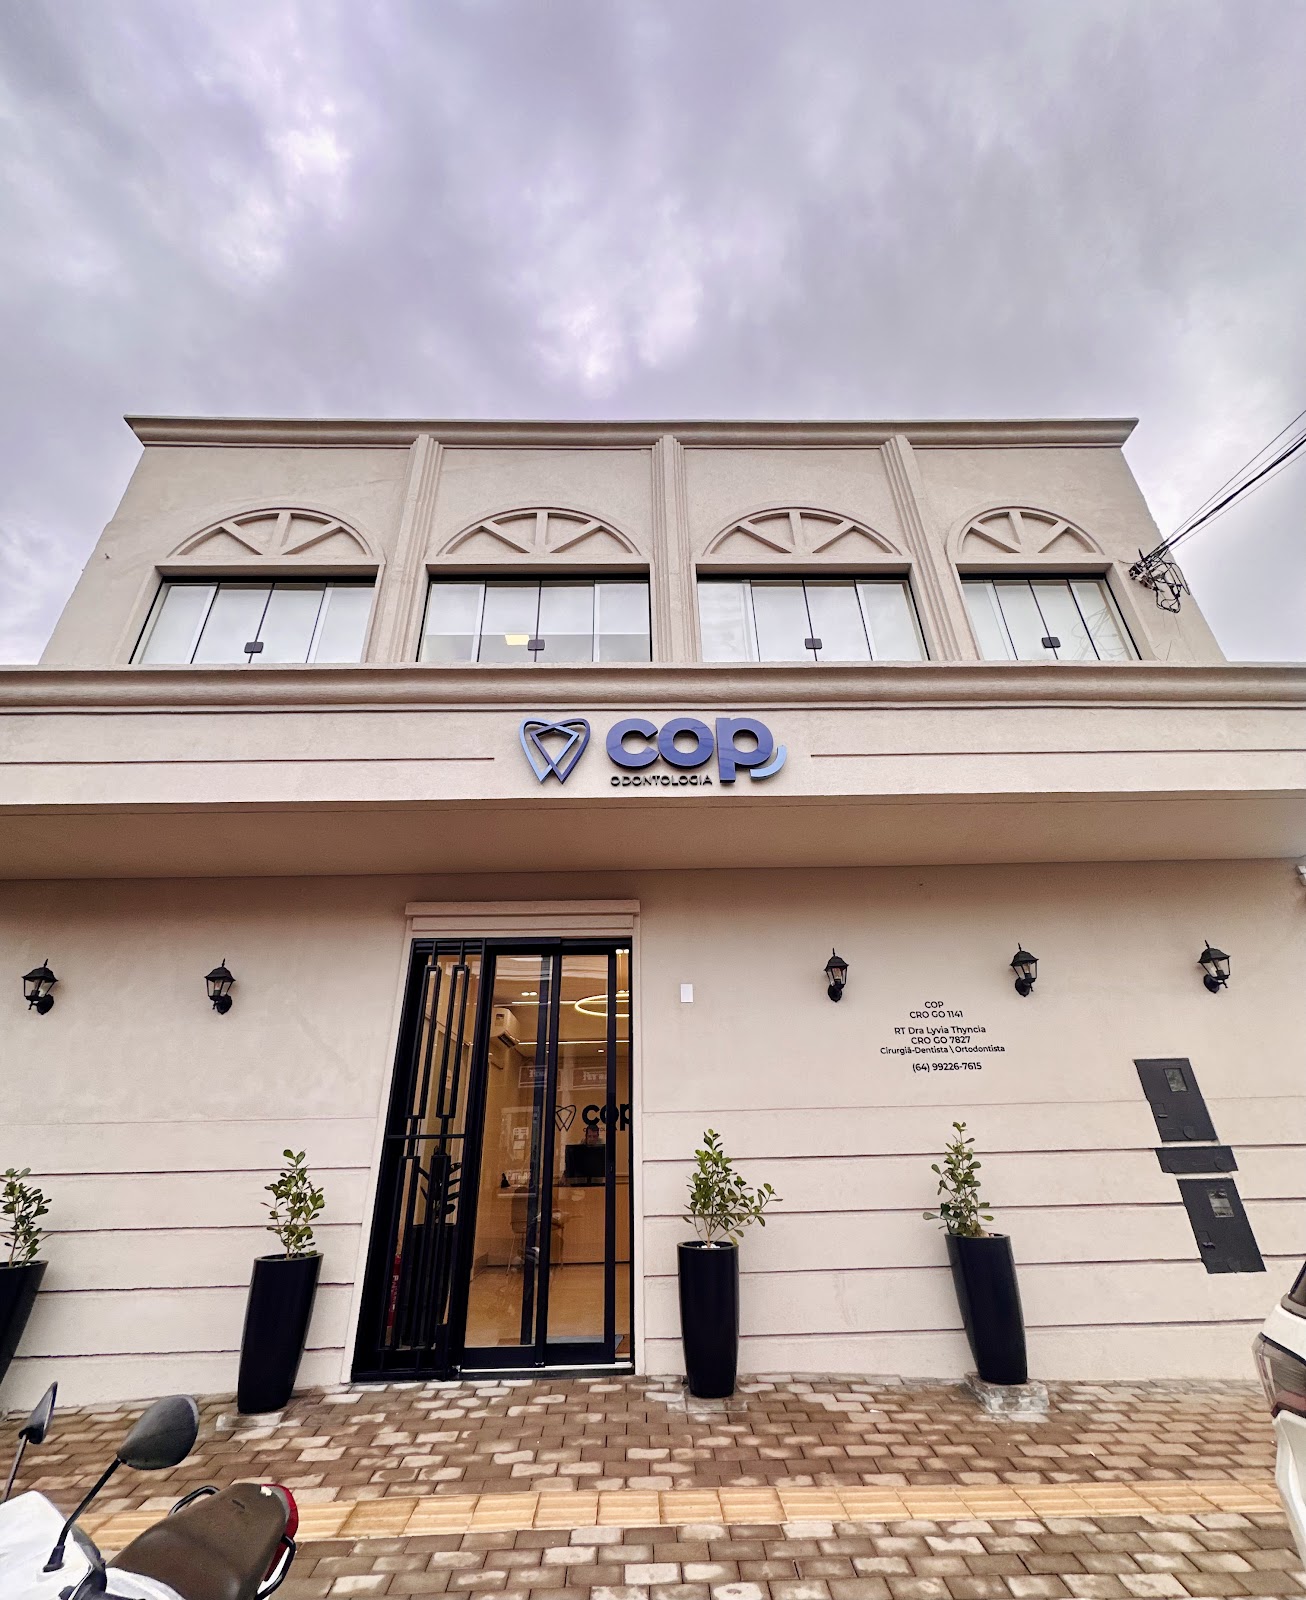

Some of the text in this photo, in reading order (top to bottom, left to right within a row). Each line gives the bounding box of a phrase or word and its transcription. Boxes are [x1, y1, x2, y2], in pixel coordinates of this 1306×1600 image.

[606, 717, 774, 784] cop
[610, 774, 713, 787] ODONTOLOGIA
[924, 1001, 944, 1009] COP
[947, 1010, 963, 1018] 1141
[894, 1025, 986, 1036] RT Dra Lyvia Thyncia
[911, 1036, 971, 1044] CRO GO 7827
[955, 1044, 1005, 1053] Ortodontista
[912, 1062, 982, 1073] (64) 99226-7615
